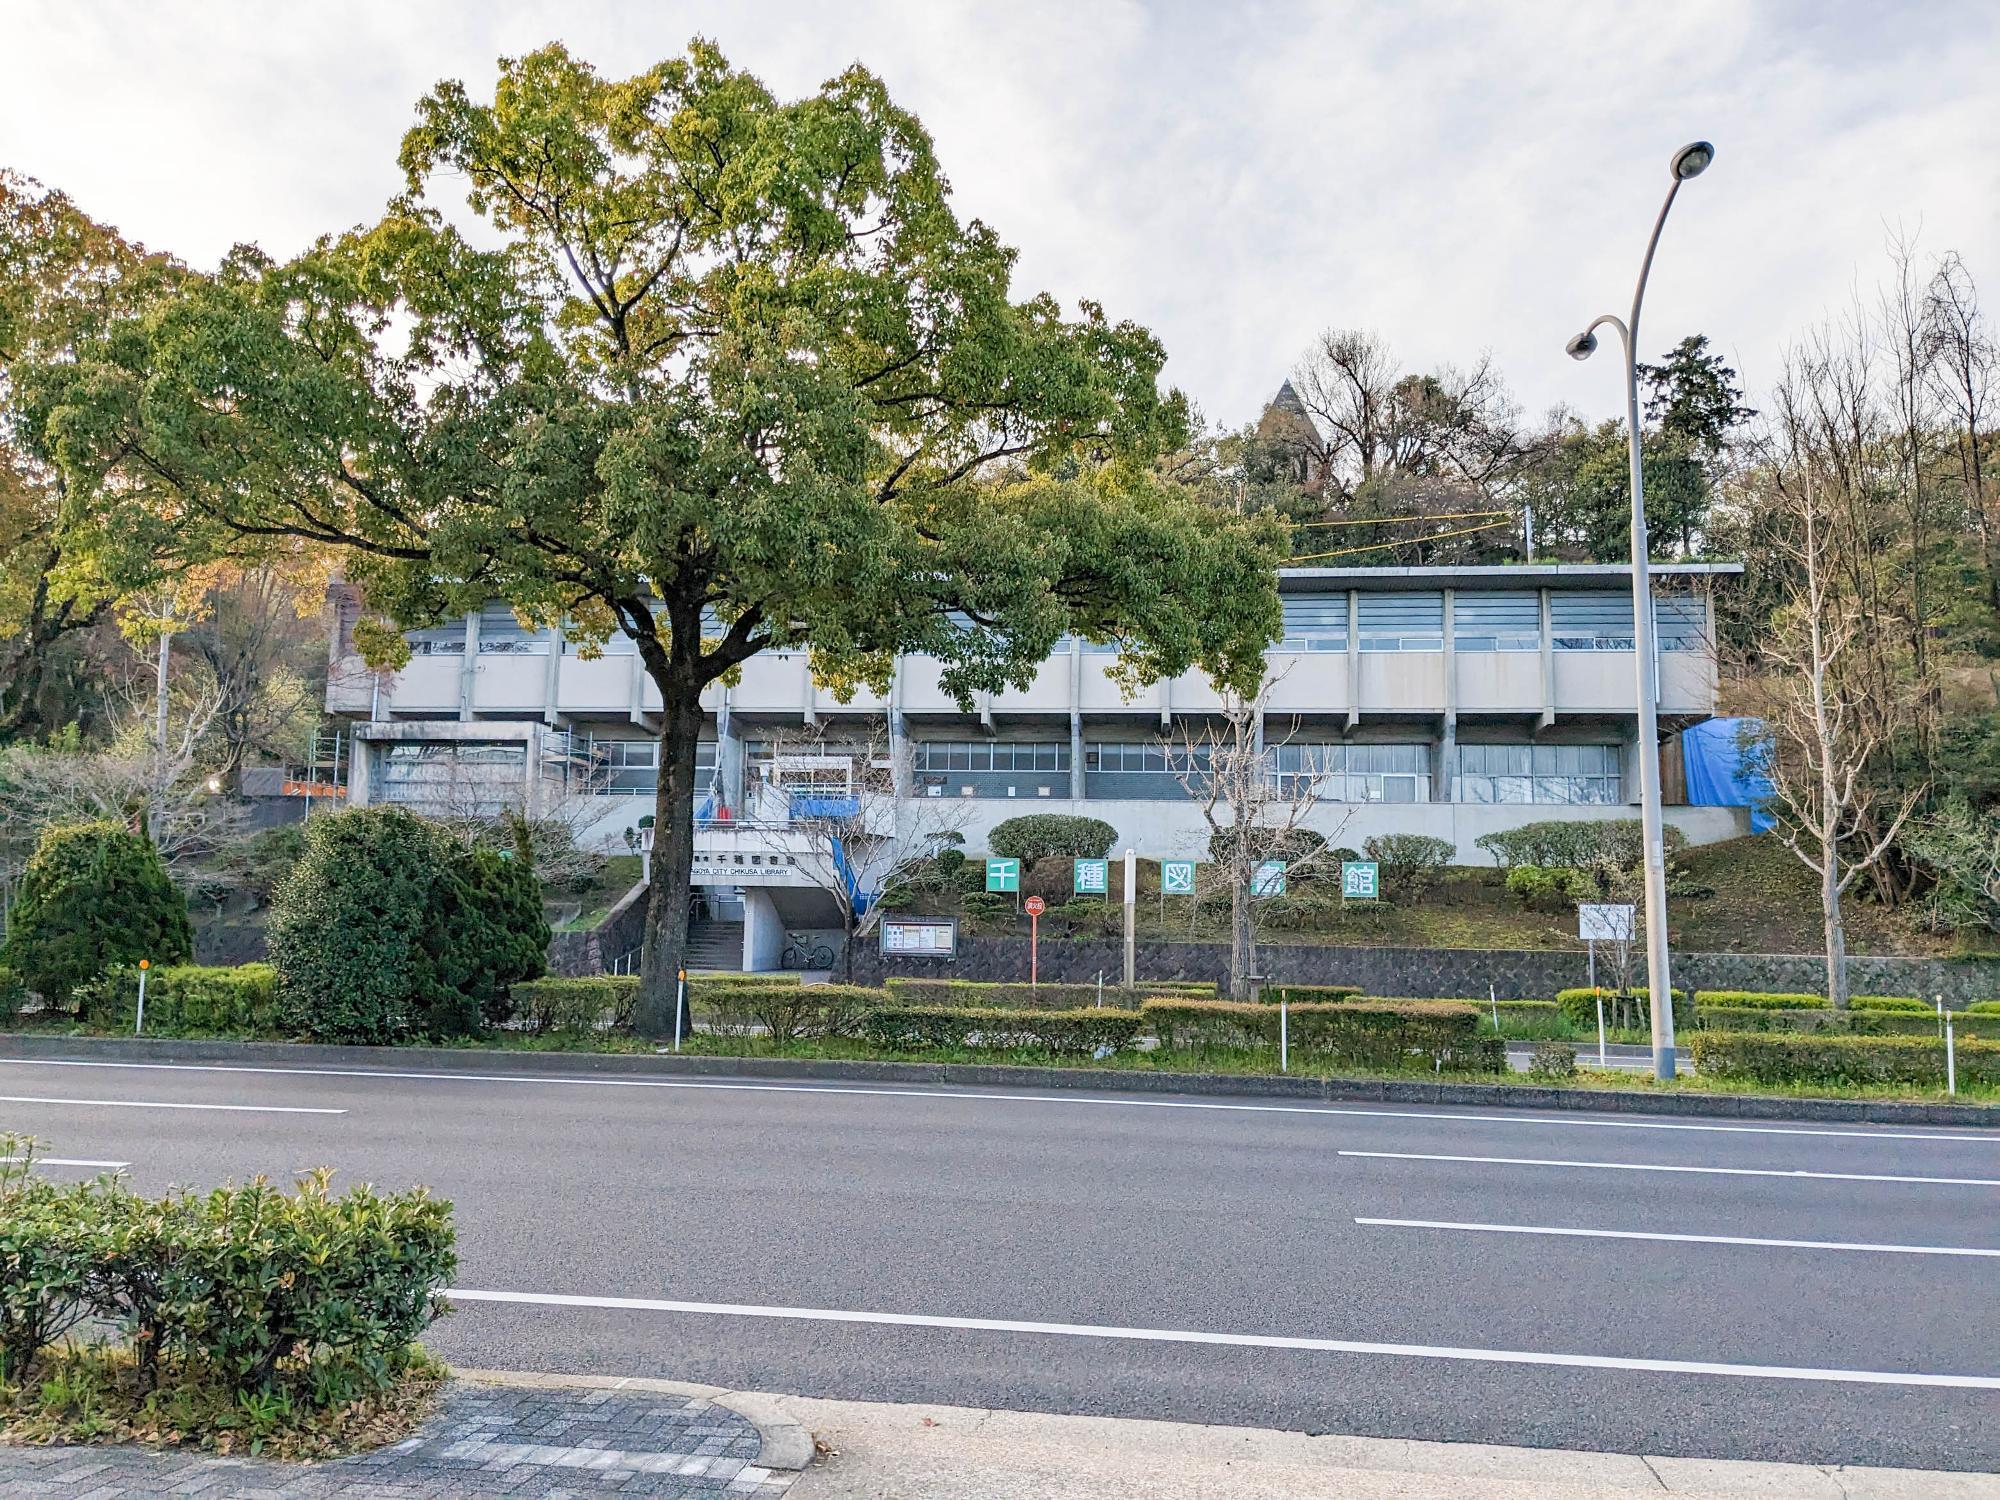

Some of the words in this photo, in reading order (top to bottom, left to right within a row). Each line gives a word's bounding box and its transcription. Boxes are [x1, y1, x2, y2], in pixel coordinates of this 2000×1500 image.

[989, 861, 1017, 889] 千
[1077, 862, 1104, 890] 種
[1165, 863, 1192, 892] 図
[1345, 866, 1375, 894] 館
